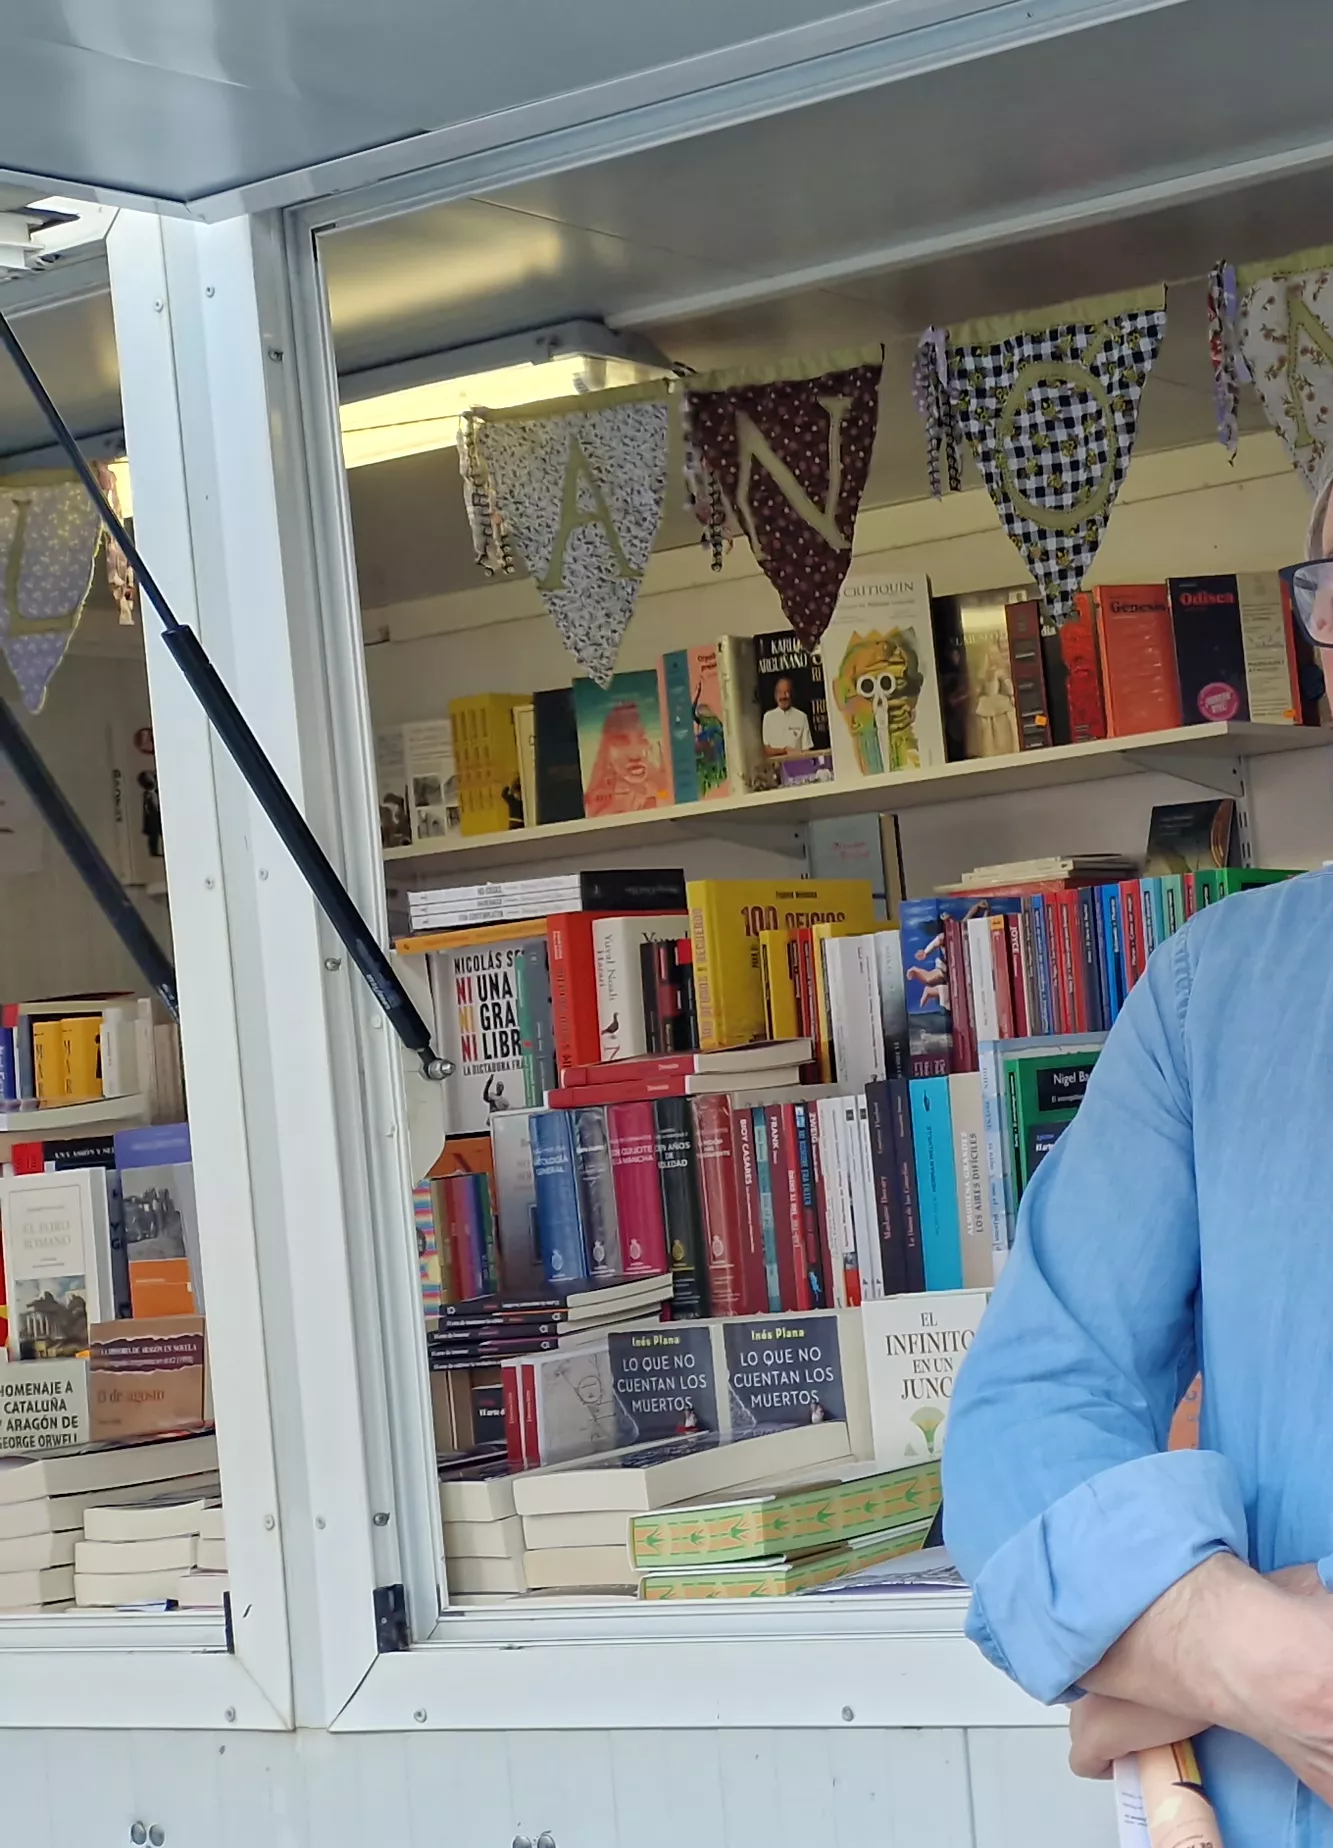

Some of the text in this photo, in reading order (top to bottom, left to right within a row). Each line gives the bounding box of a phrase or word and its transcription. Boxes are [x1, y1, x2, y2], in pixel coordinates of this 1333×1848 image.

[741, 906, 778, 937] 100
[1009, 926, 1019, 954] JOYCE
[454, 952, 502, 975] NICOLÁS
[456, 972, 513, 1005] NI UNA
[459, 1002, 517, 1032] NI GRA
[461, 1034, 521, 1062] NI LIBR
[1053, 1072, 1076, 1088] Nigel
[771, 1116, 779, 1149] FRANK
[809, 1112, 817, 1143] ZWEIG
[668, 1141, 691, 1151] AÑOS
[739, 1119, 752, 1184] BIOY CASARES
[969, 1132, 983, 1233] LOS AIRES DIFÍCILES
[921, 1312, 938, 1327] EL
[632, 1334, 681, 1347] Inés Plana
[751, 1328, 804, 1341] Inés Plana
[886, 1329, 974, 1356] INFINITO
[623, 1353, 695, 1373] LO QUE NO
[740, 1346, 822, 1367] LO QUE NO
[912, 1357, 953, 1374] EN UN
[65, 1380, 73, 1393] A
[617, 1374, 707, 1393] CUENTAN LOS
[733, 1367, 834, 1389] CUENTAN LOS
[901, 1376, 953, 1400] JUNC
[4, 1397, 67, 1414] CATALUÑA
[632, 1396, 693, 1412] MUERTOS
[751, 1389, 819, 1408] MUERTOS
[6, 1415, 79, 1432] ARAGÓN DE
